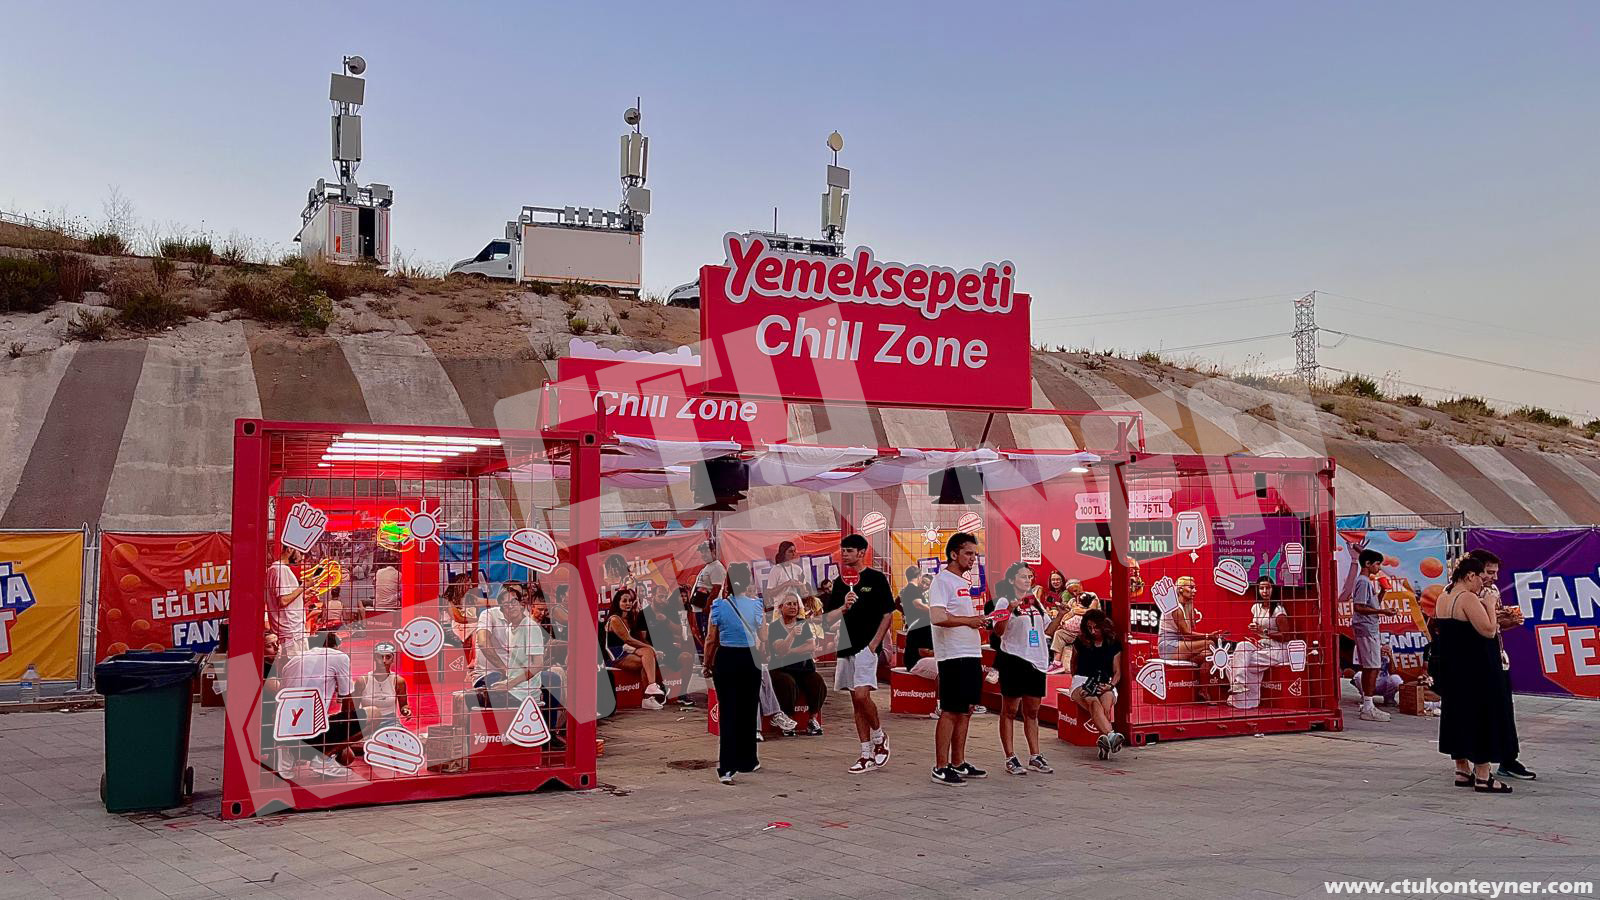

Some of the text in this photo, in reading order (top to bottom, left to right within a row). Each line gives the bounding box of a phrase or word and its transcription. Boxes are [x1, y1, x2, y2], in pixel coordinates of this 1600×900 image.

[727, 236, 1013, 315] Yemeksepeti
[755, 313, 989, 369] Chill Zone
[593, 390, 758, 422] Chill Zone
[1093, 505, 1102, 515] TL
[1154, 503, 1164, 513] TL
[1080, 536, 1105, 552] 250
